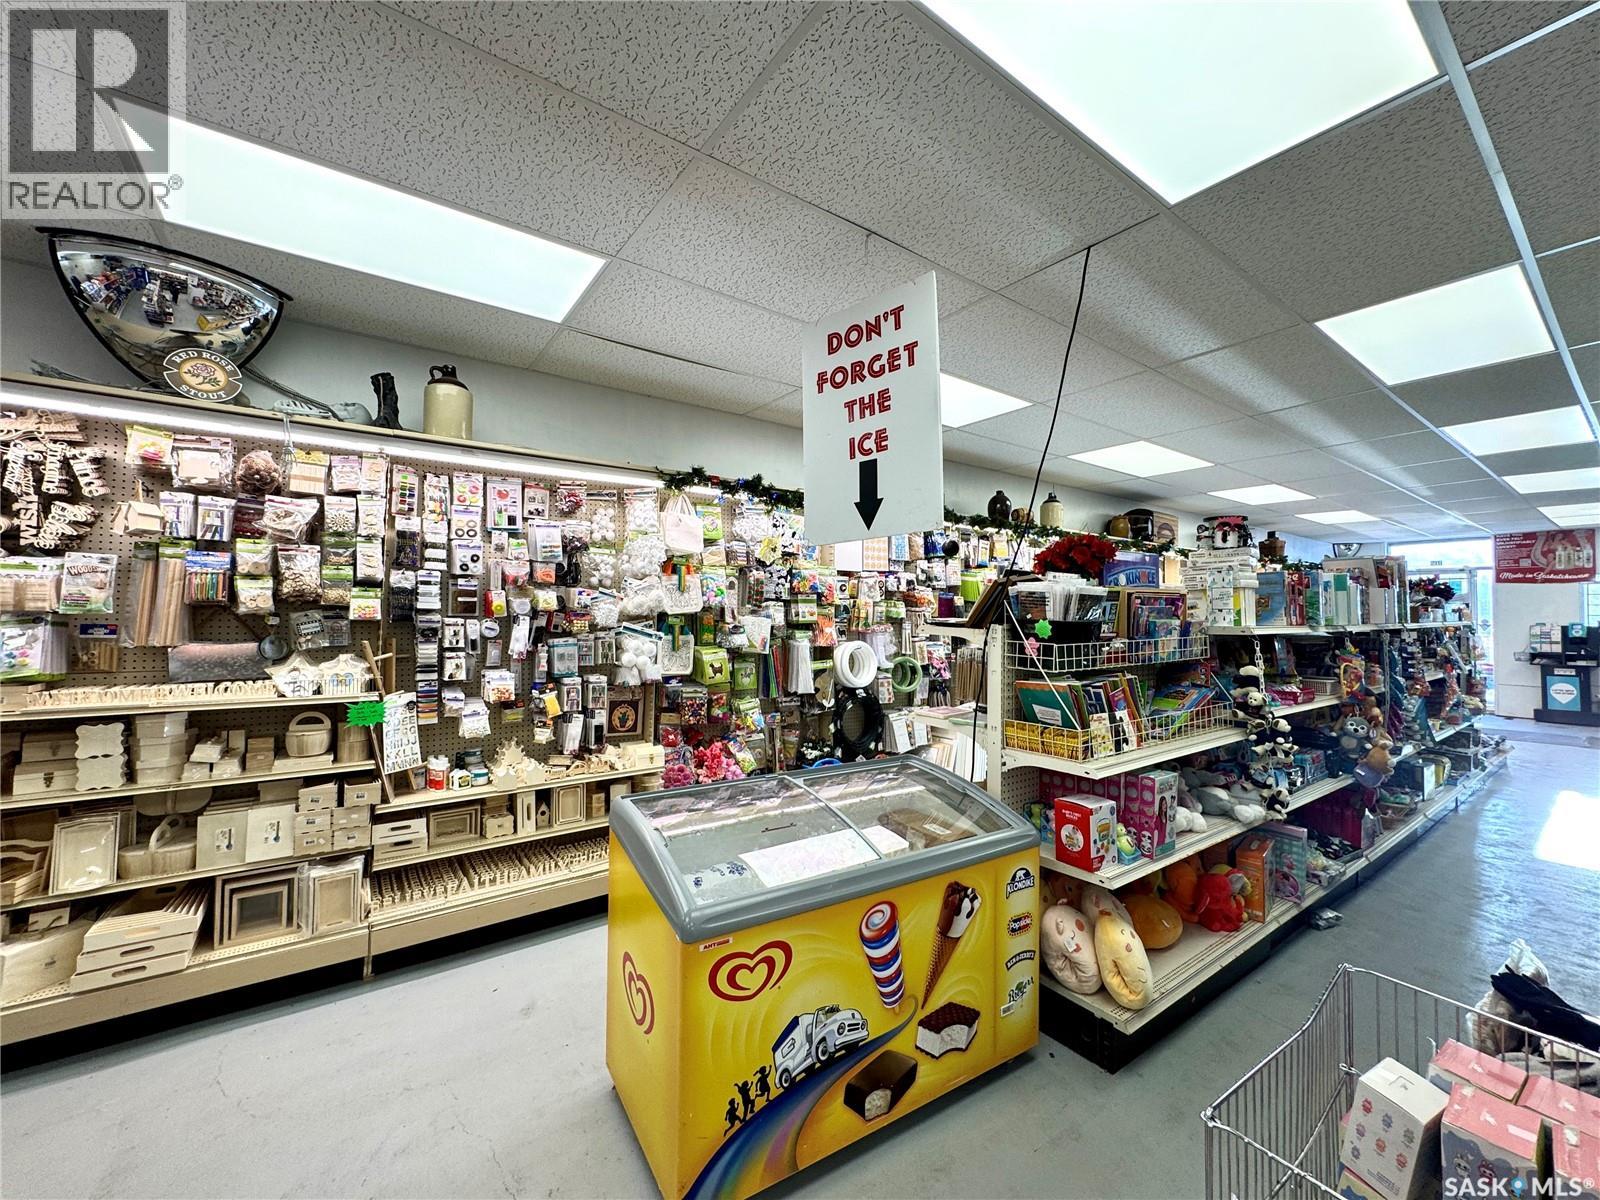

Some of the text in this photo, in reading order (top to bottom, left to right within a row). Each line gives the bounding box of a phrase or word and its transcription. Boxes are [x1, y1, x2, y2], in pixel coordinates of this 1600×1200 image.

[827, 304, 905, 356] DON'T
[171, 350, 235, 372] RED ROSE
[816, 341, 919, 394] FORGET
[179, 384, 227, 399] STOUT
[844, 387, 892, 423] THE
[849, 427, 889, 460] ICE
[1007, 877, 1034, 896] KLONDIKE
